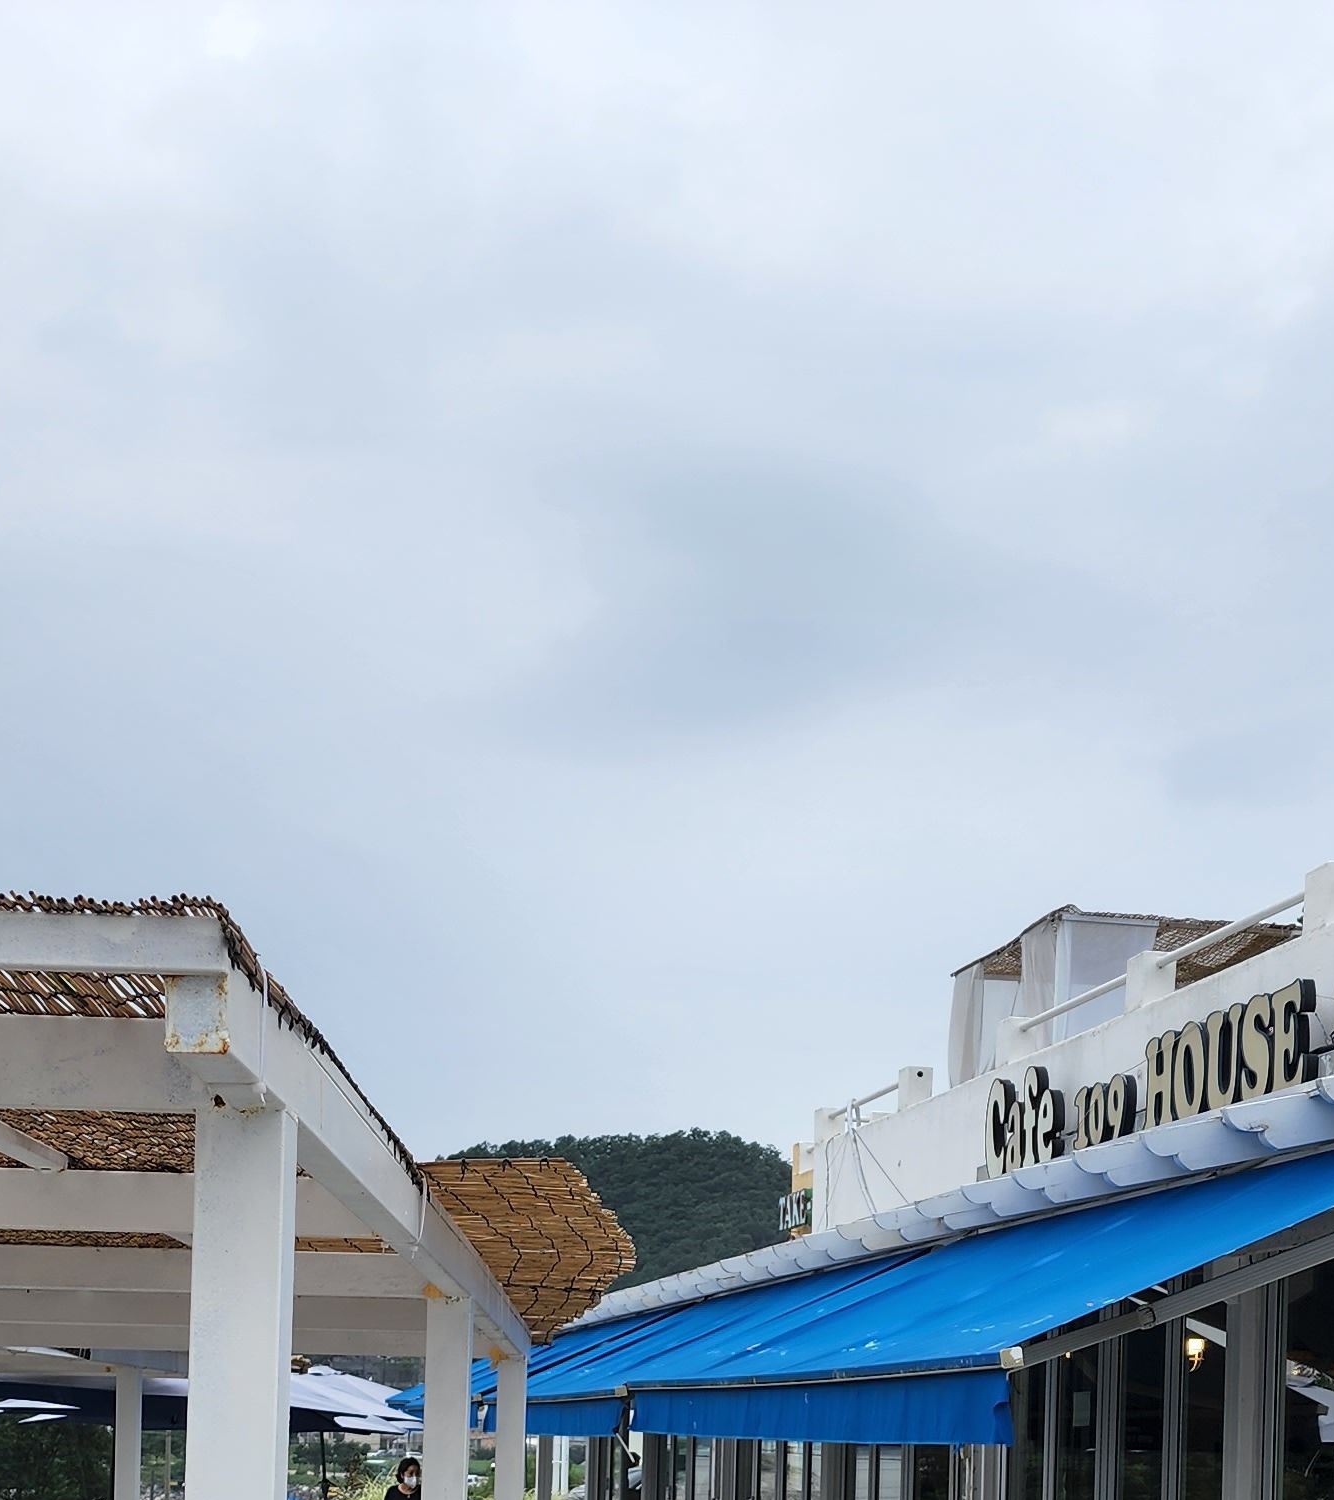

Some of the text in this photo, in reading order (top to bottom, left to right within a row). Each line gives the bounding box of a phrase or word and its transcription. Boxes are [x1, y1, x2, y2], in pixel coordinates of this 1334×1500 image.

[985, 1066, 1062, 1179] Cafe
[1073, 1073, 1136, 1150] 109
[1144, 978, 1317, 1130] HOUSE
